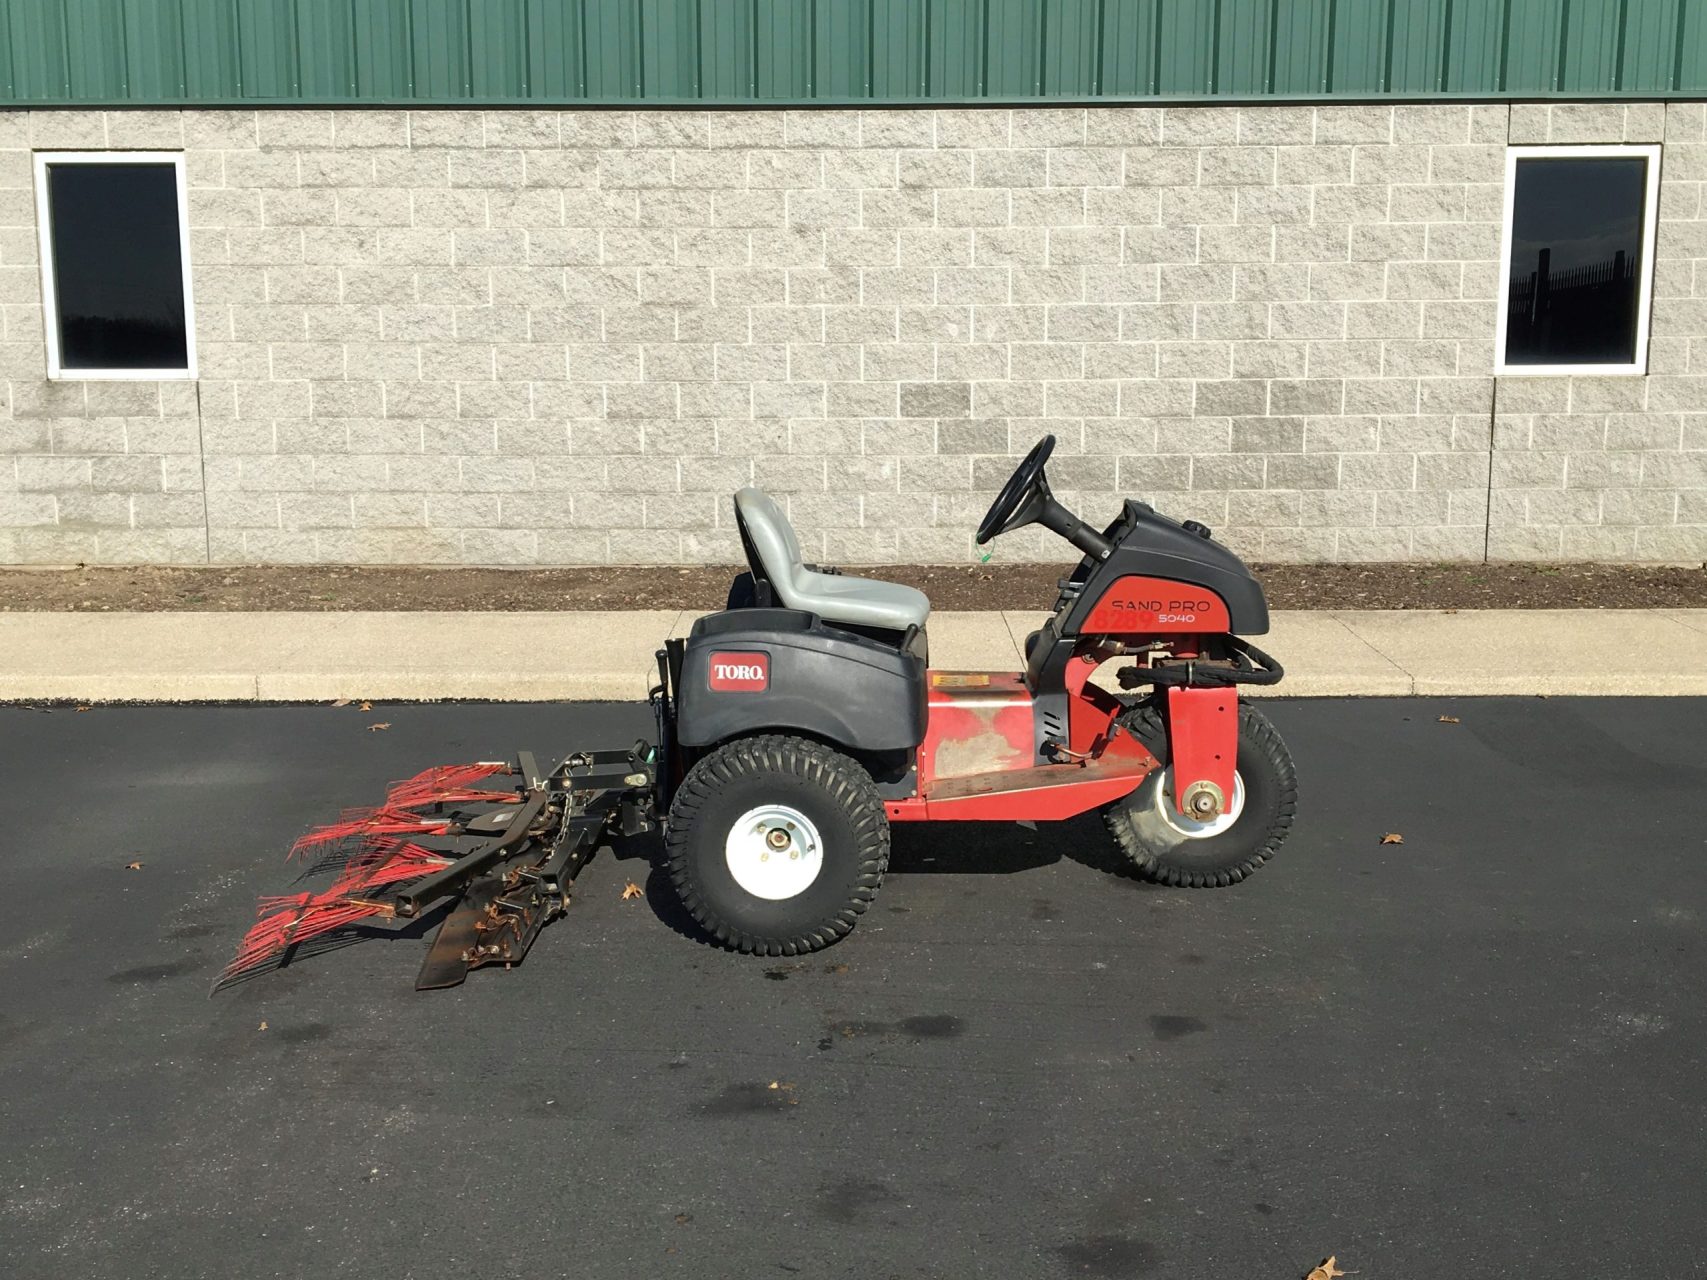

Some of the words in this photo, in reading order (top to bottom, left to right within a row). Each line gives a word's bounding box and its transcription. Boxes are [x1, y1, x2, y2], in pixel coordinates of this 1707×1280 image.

[1111, 600, 1162, 612] SAND
[1168, 600, 1211, 612] PRO
[1158, 614, 1195, 623] 5040
